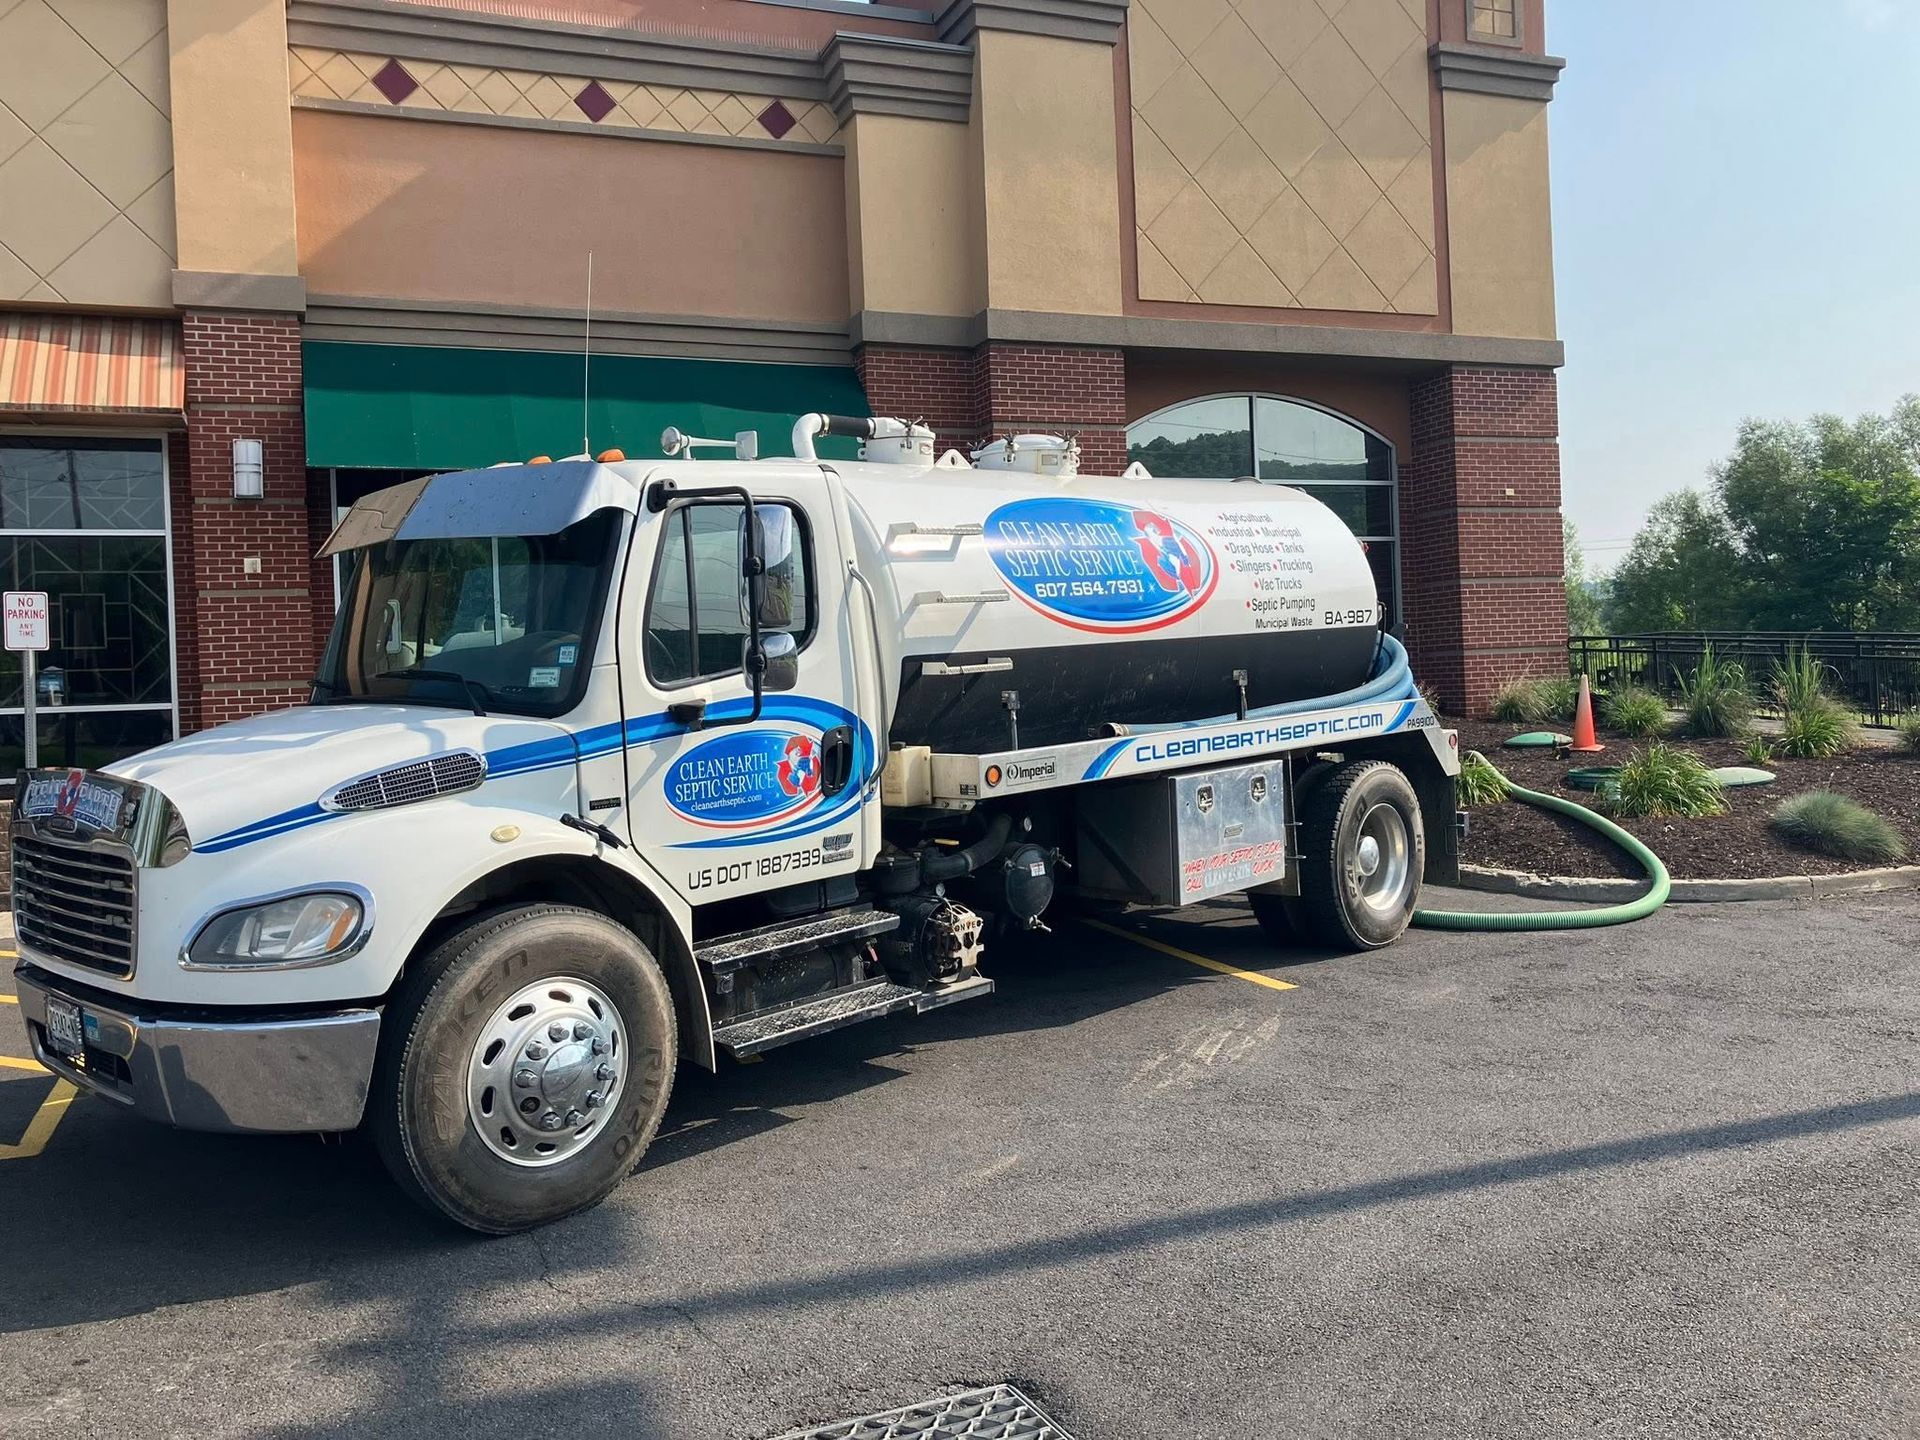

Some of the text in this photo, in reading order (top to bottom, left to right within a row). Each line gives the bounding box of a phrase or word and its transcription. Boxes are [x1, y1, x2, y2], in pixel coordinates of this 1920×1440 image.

[1223, 513, 1272, 524] Agricultural
[999, 520, 1125, 547] CLEAN EARTH
[1213, 527, 1302, 538] Industrial Municipal
[1229, 542, 1304, 556] Drag Hose Tanks
[1005, 549, 1144, 577] SEPTIC SERVICE
[1236, 559, 1313, 575] Slingers Trucking
[1035, 579, 1145, 598] 607.564.7931
[1259, 577, 1302, 591] Vac Trucks
[18, 597, 34, 607] NO
[1252, 597, 1315, 614] Septic Pumping
[8, 609, 45, 620] PARKING
[1255, 617, 1313, 629] Municipal Waste
[680, 752, 768, 781] CLEAN EARTH
[1019, 761, 1055, 780] Imperial
[675, 771, 775, 803] SEPTIC SERVICE
[690, 794, 762, 812] cleanearthseptic.com
[688, 868, 712, 890] US
[717, 861, 752, 885] DOT
[756, 848, 821, 877] 1887339
